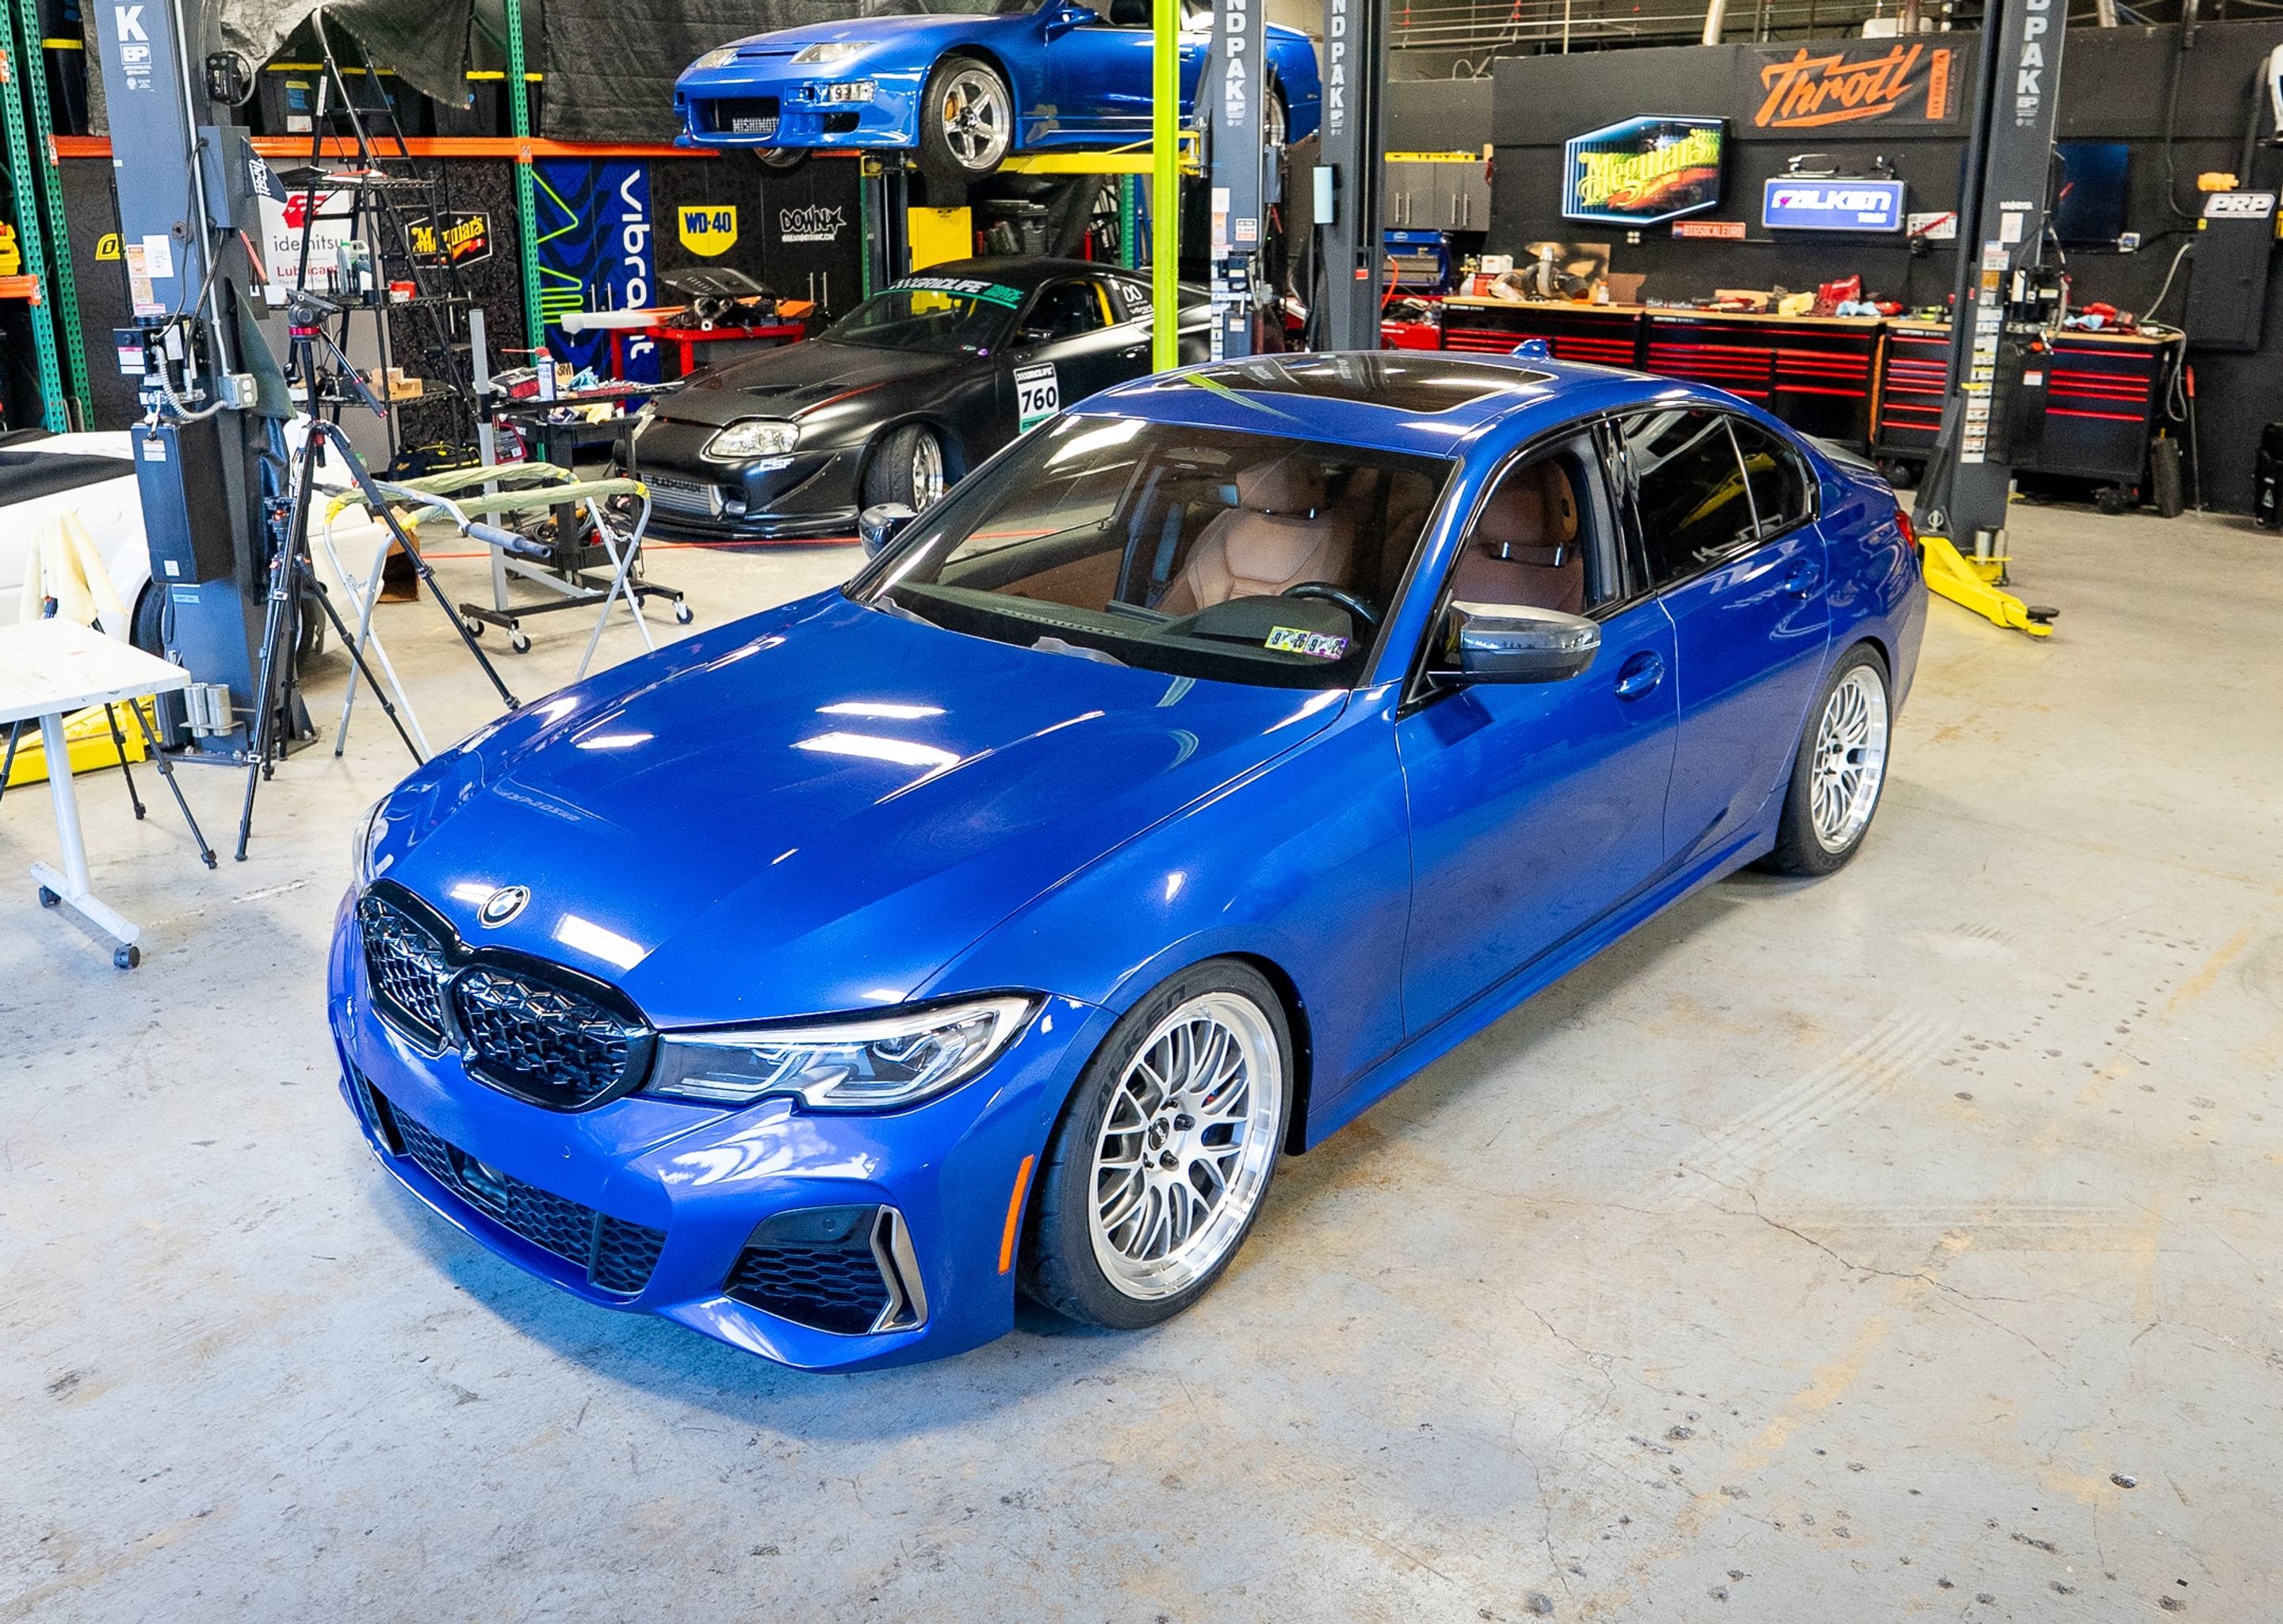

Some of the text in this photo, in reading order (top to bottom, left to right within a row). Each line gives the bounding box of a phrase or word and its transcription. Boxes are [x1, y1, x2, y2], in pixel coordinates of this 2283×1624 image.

[732, 117, 779, 133] MISHIMOT
[1577, 128, 1712, 207] Meguiar's
[1771, 189, 1892, 211] FALKEN
[2208, 196, 2273, 212] PRP
[684, 211, 733, 234] WD-40
[620, 169, 654, 360] vibrat
[1019, 386, 1057, 414] 760
[1272, 632, 1282, 645] 9
[1309, 639, 1318, 652] 9
